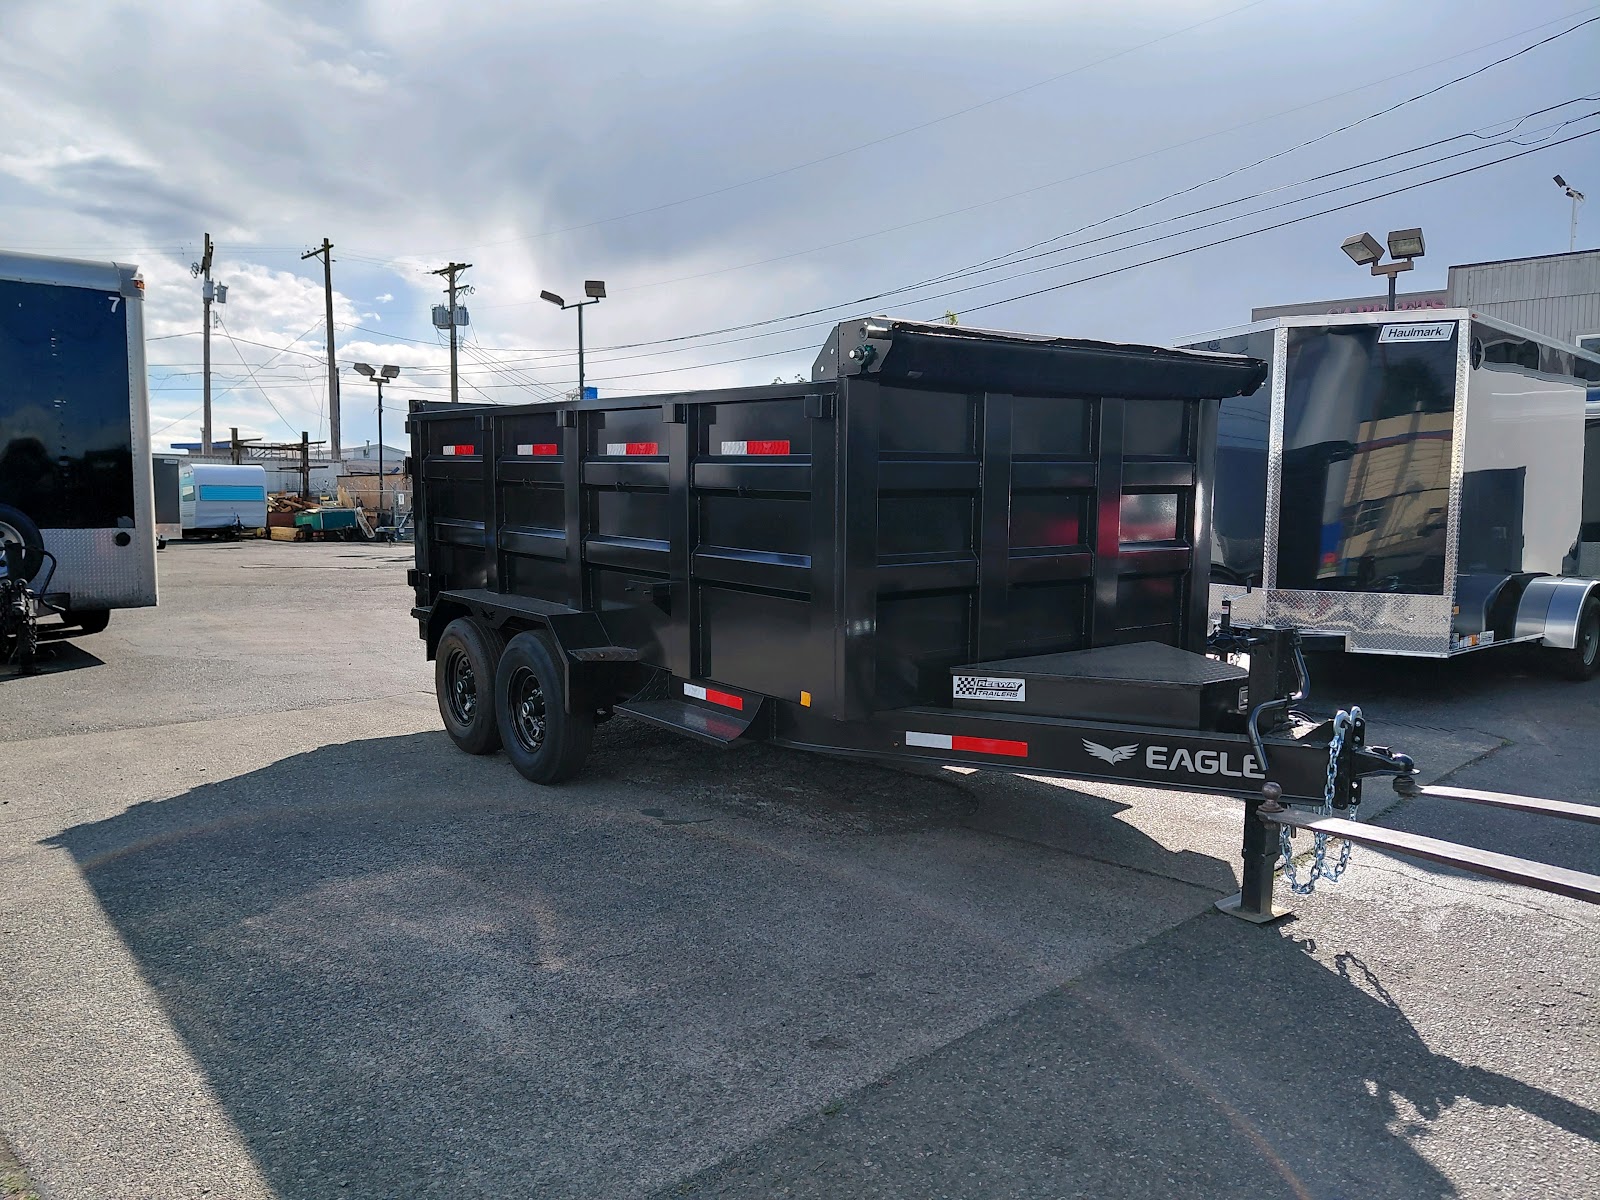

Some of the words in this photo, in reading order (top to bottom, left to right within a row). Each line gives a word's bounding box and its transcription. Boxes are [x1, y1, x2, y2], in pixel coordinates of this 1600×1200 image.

[108, 296, 120, 313] 7
[1388, 326, 1443, 338] Haulmark
[978, 690, 1018, 698] TRAILERS
[1145, 745, 1266, 780] EAGLE
